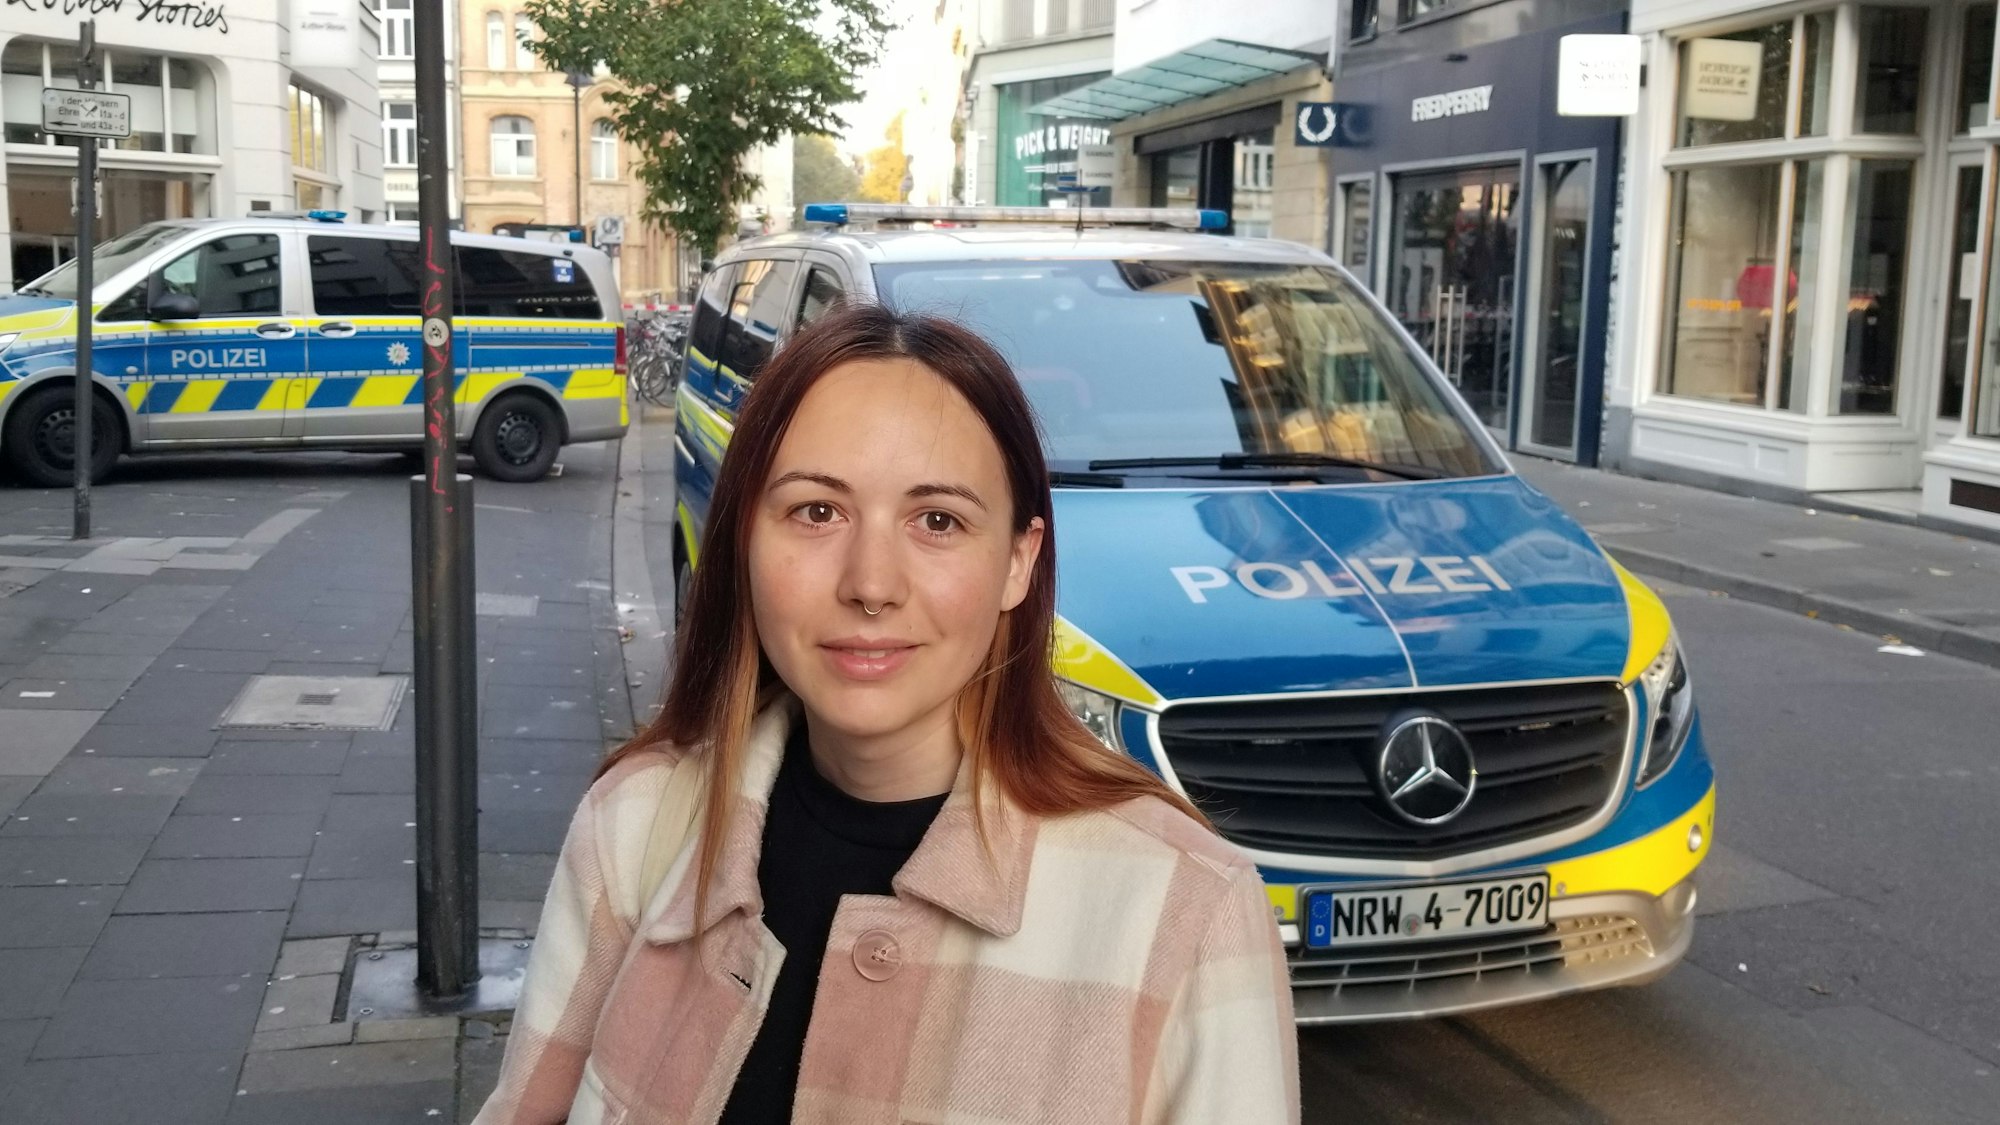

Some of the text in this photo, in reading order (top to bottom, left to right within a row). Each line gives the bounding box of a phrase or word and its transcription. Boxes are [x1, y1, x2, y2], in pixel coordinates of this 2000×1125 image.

[80, 121, 96, 129] und
[1015, 125, 1111, 160] PICK & WEIGHT
[171, 347, 267, 369] POLIZEI
[1169, 555, 1512, 604] POLIZEI
[1332, 882, 1545, 937] NRW 4-7009
[1314, 924, 1326, 937] D
